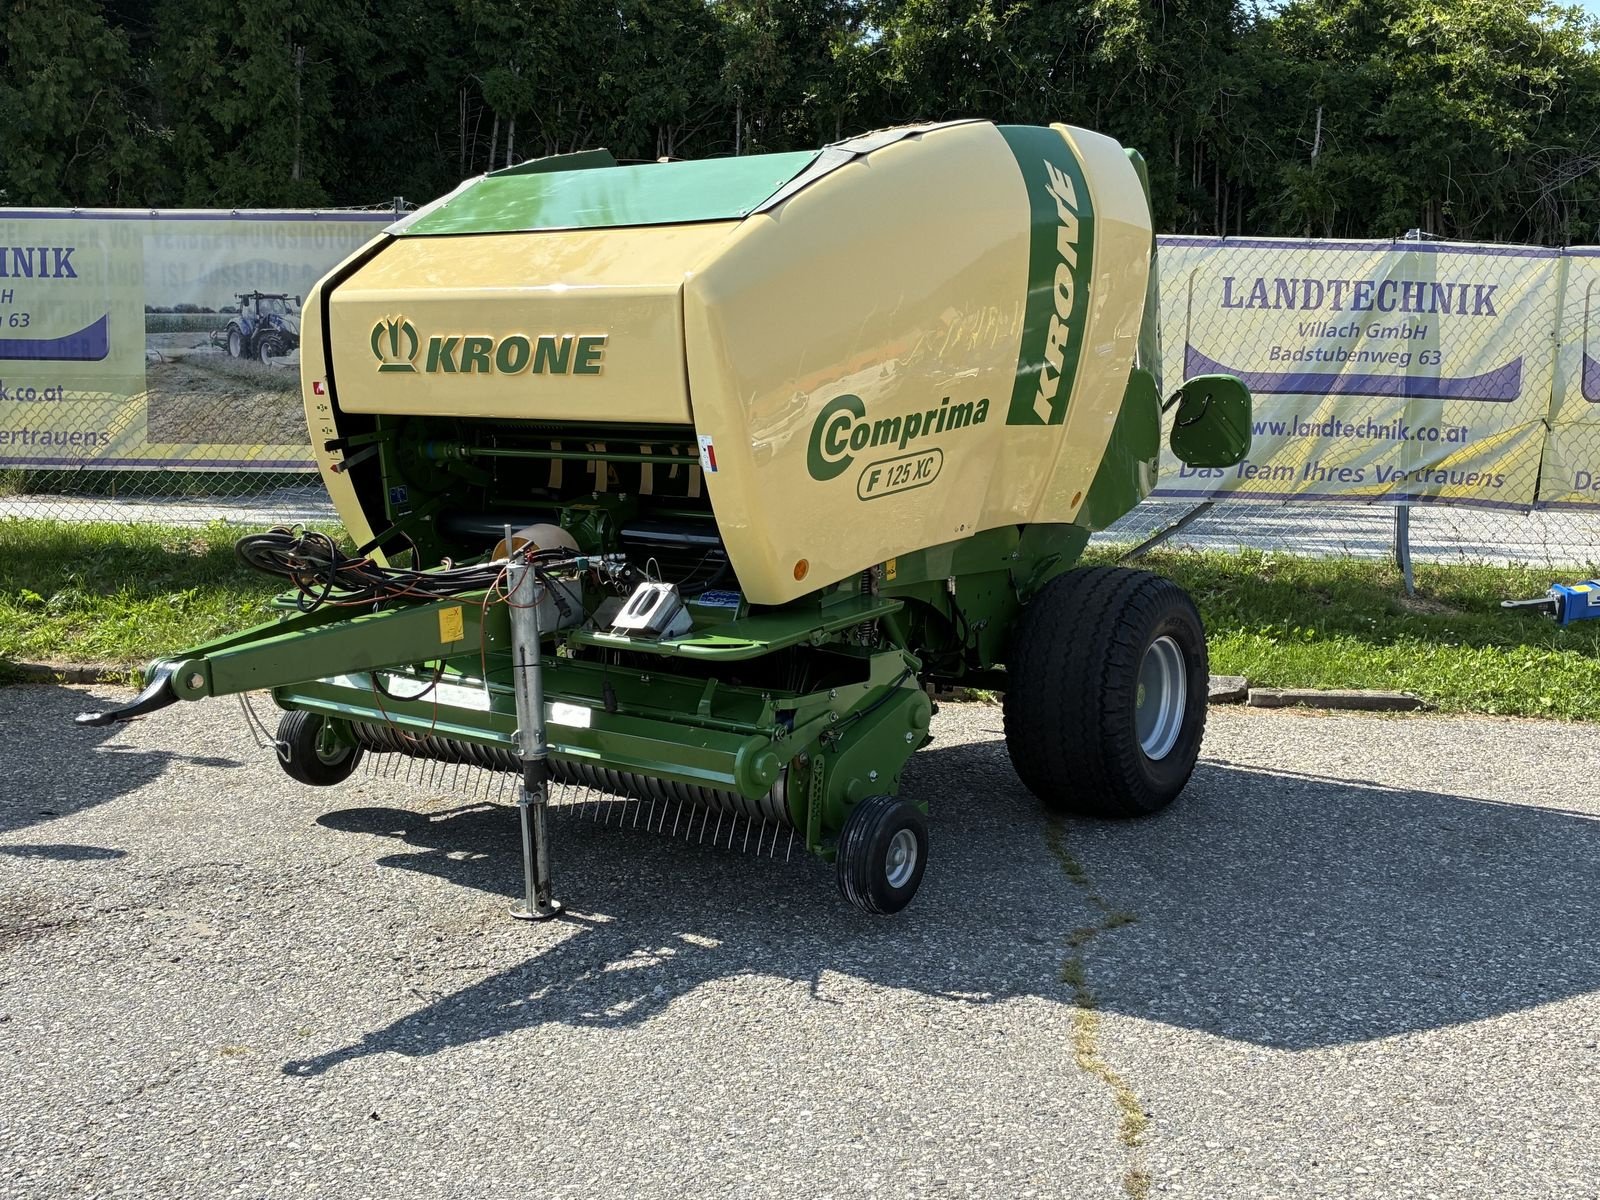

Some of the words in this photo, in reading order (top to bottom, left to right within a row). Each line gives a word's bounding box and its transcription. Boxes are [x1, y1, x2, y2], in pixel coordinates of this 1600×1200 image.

[1032, 158, 1079, 425] KRONE
[1221, 276, 1498, 316] LANDTECHNIK
[9, 313, 30, 328] 63
[1298, 321, 1360, 338] Villach
[1366, 323, 1428, 340] GmbH
[424, 334, 608, 376] KRONE
[1269, 346, 1412, 368] Badstubenweg
[1418, 350, 1442, 366] 63
[807, 394, 990, 482] Comprima
[866, 469, 882, 492] F
[886, 462, 912, 488] 125
[912, 456, 934, 481] XC
[1237, 460, 1295, 480] Team
[1303, 460, 1365, 482] Ihres
[1375, 464, 1506, 488] Vertrauens
